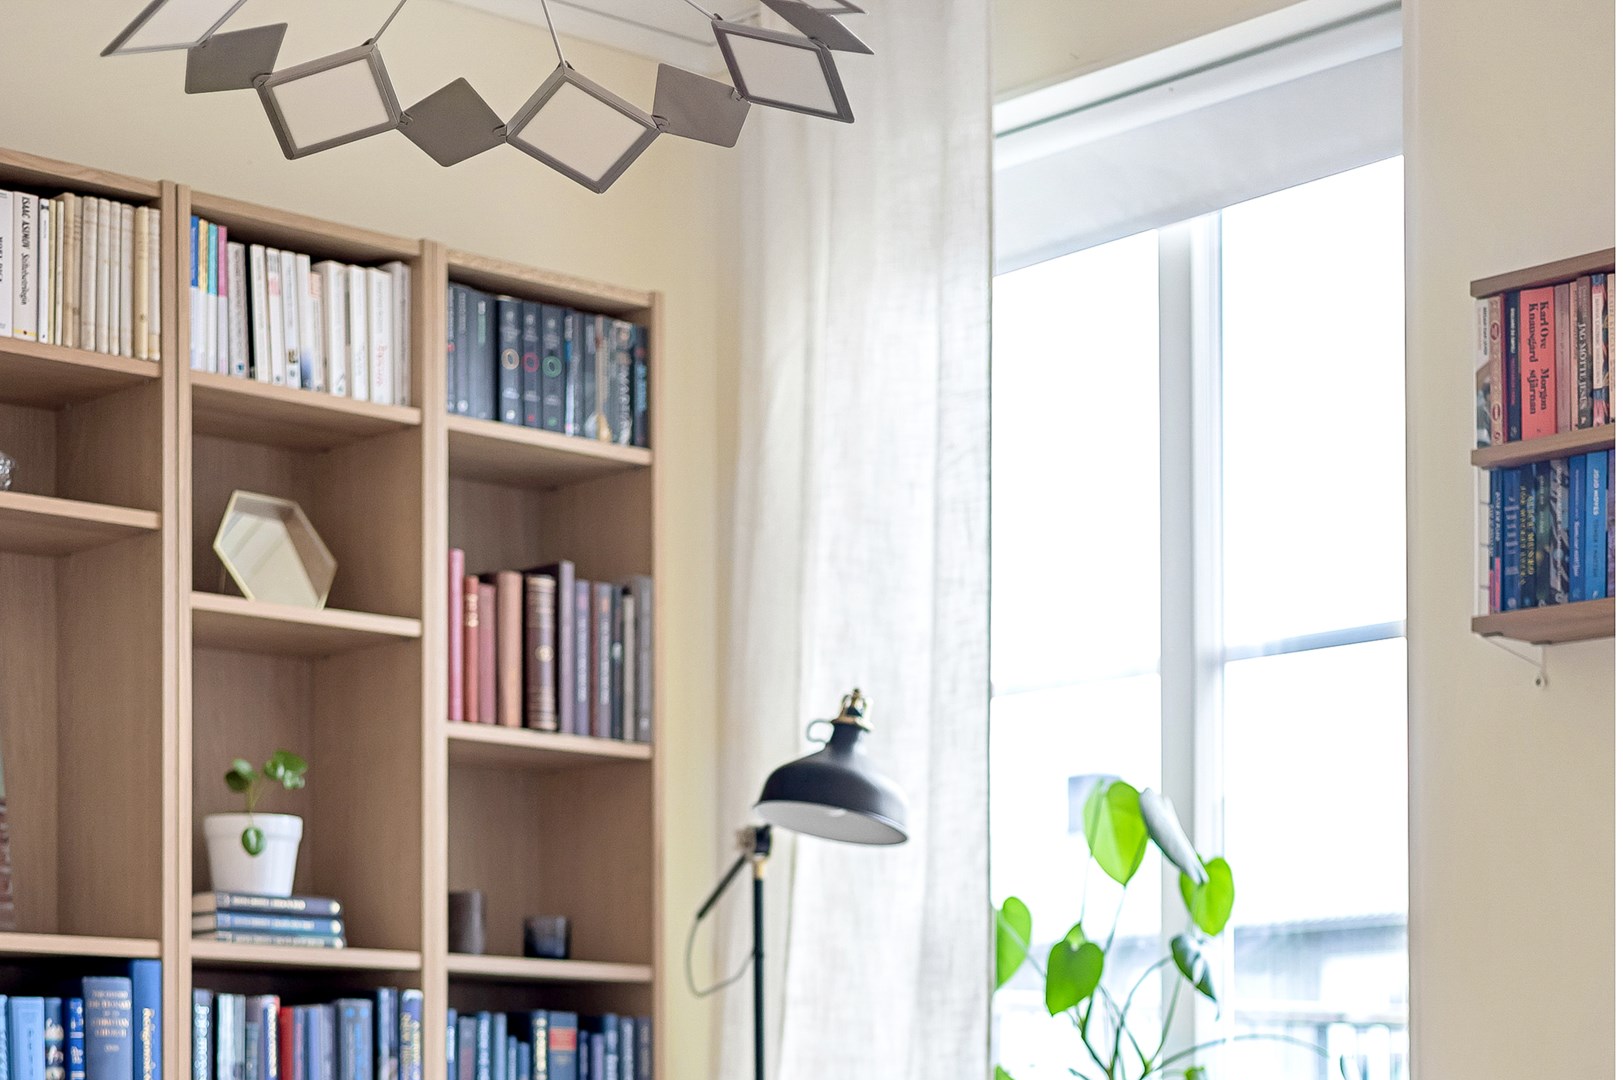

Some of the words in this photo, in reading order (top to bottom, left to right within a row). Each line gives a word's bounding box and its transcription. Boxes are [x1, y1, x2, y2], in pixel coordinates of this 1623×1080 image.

[21, 196, 30, 219] ISAAC
[1539, 301, 1549, 326] Karl
[1539, 368, 1549, 411] Morgon
